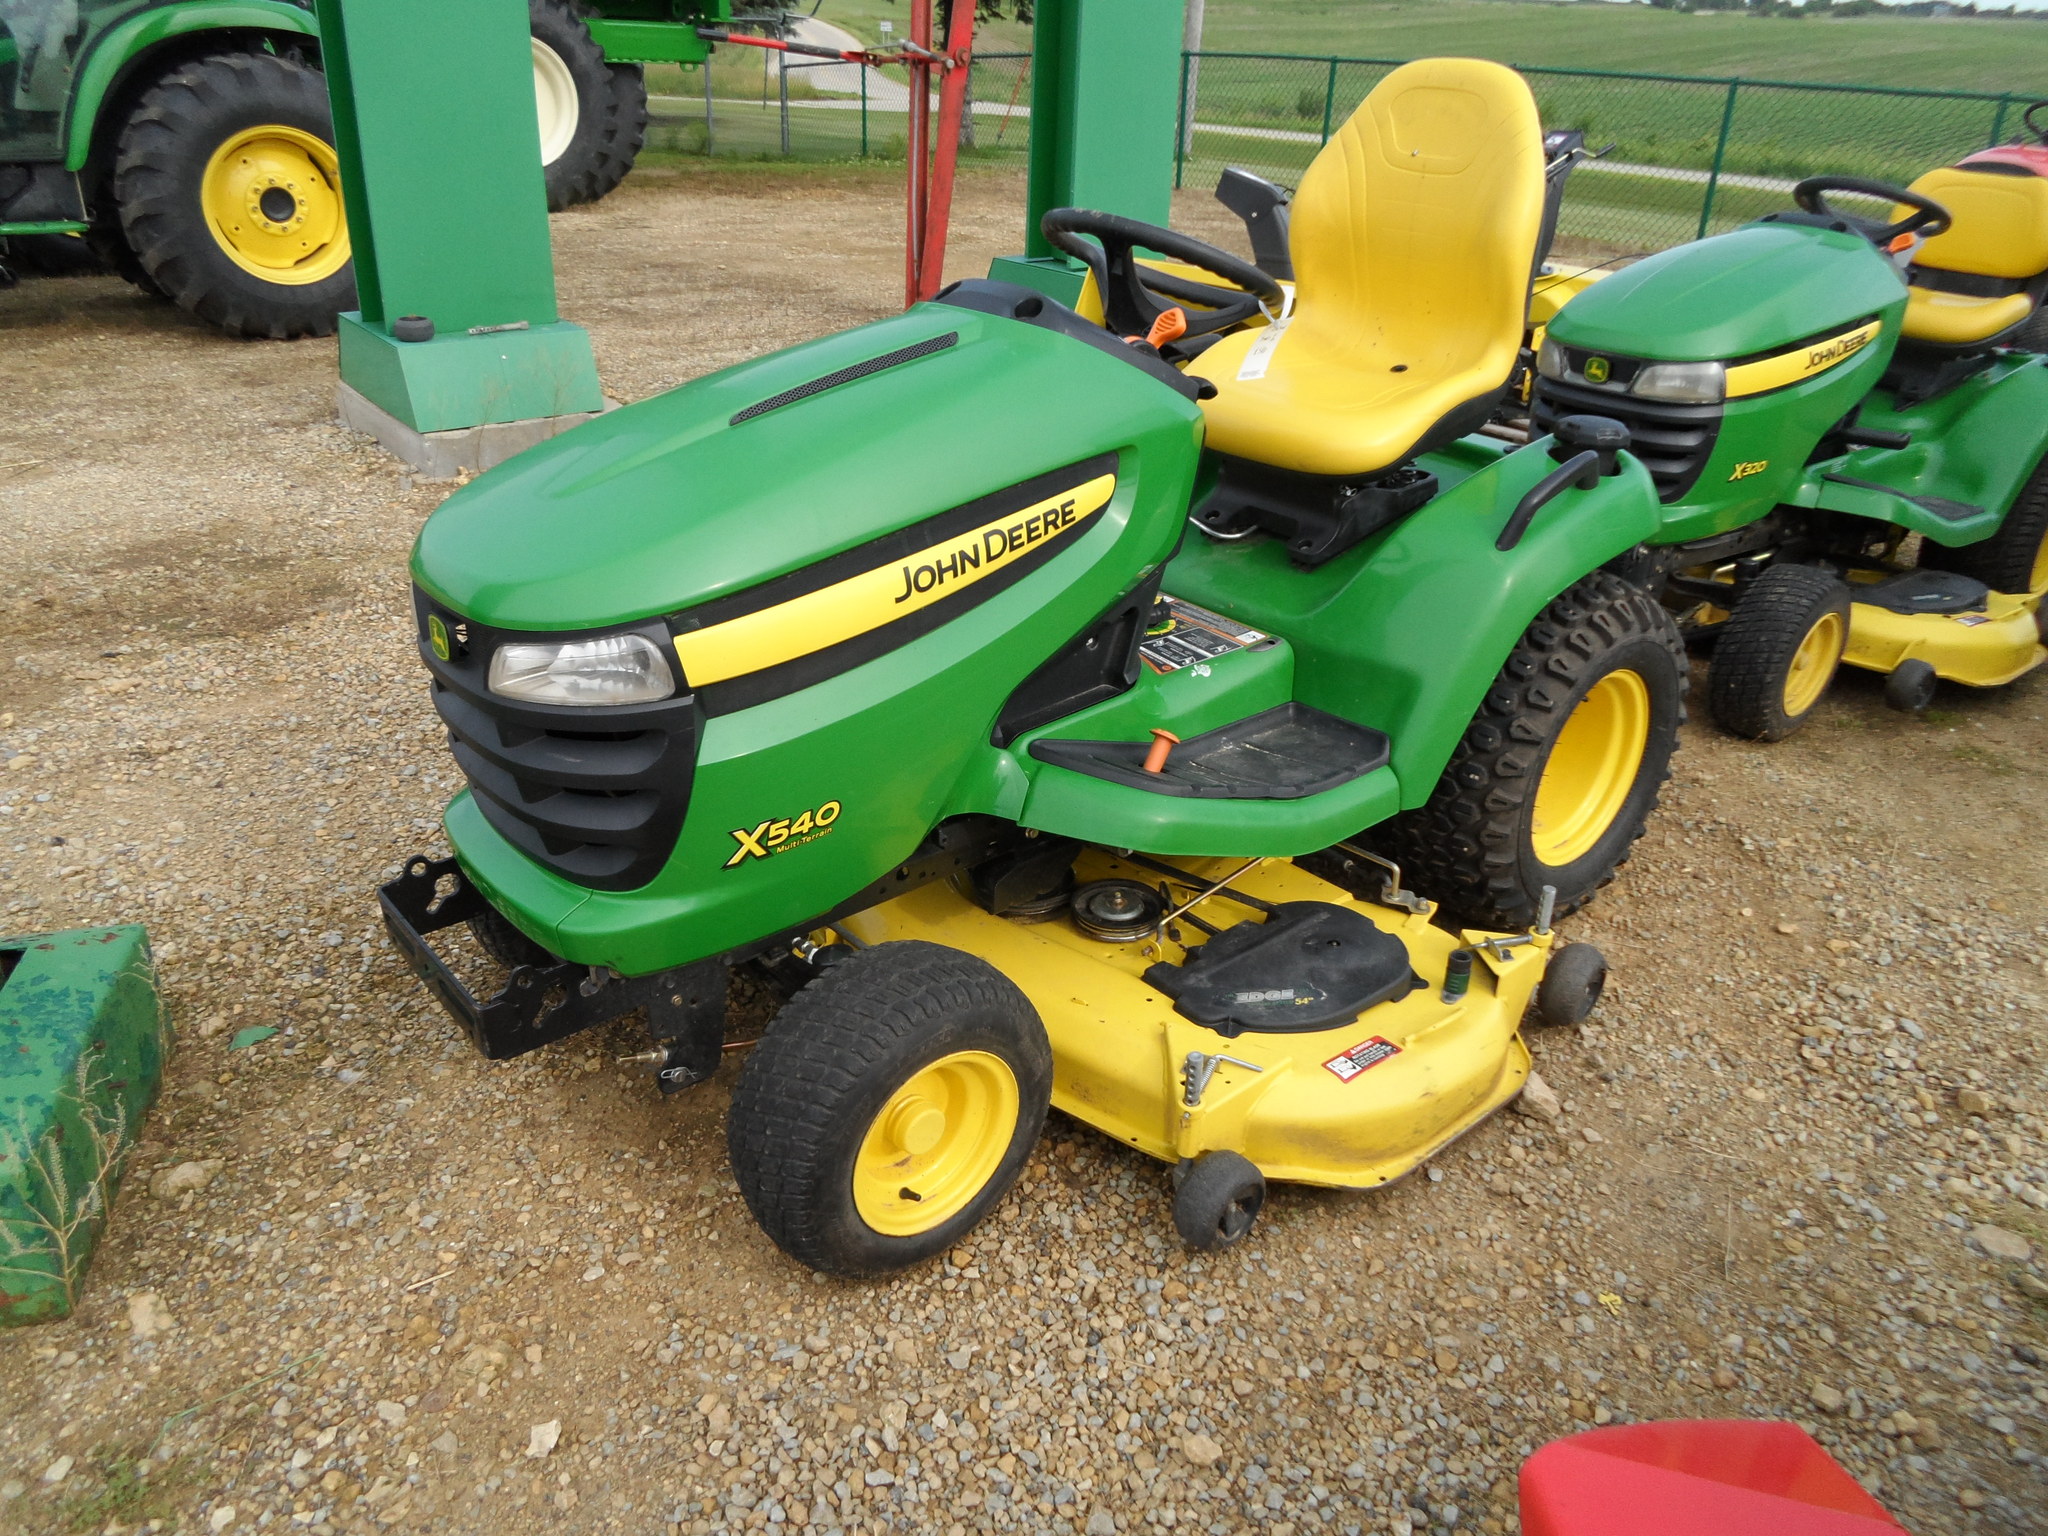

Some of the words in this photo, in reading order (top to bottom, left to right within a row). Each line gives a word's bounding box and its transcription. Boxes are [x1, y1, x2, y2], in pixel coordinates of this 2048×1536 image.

[1804, 347, 1836, 370] JOHN
[1837, 331, 1868, 356] DEERE
[1728, 460, 1769, 483] X320
[895, 543, 981, 604] JOHN
[983, 499, 1077, 563] DEERE
[721, 800, 842, 870] X540
[776, 827, 833, 854] Multi-Terrain
